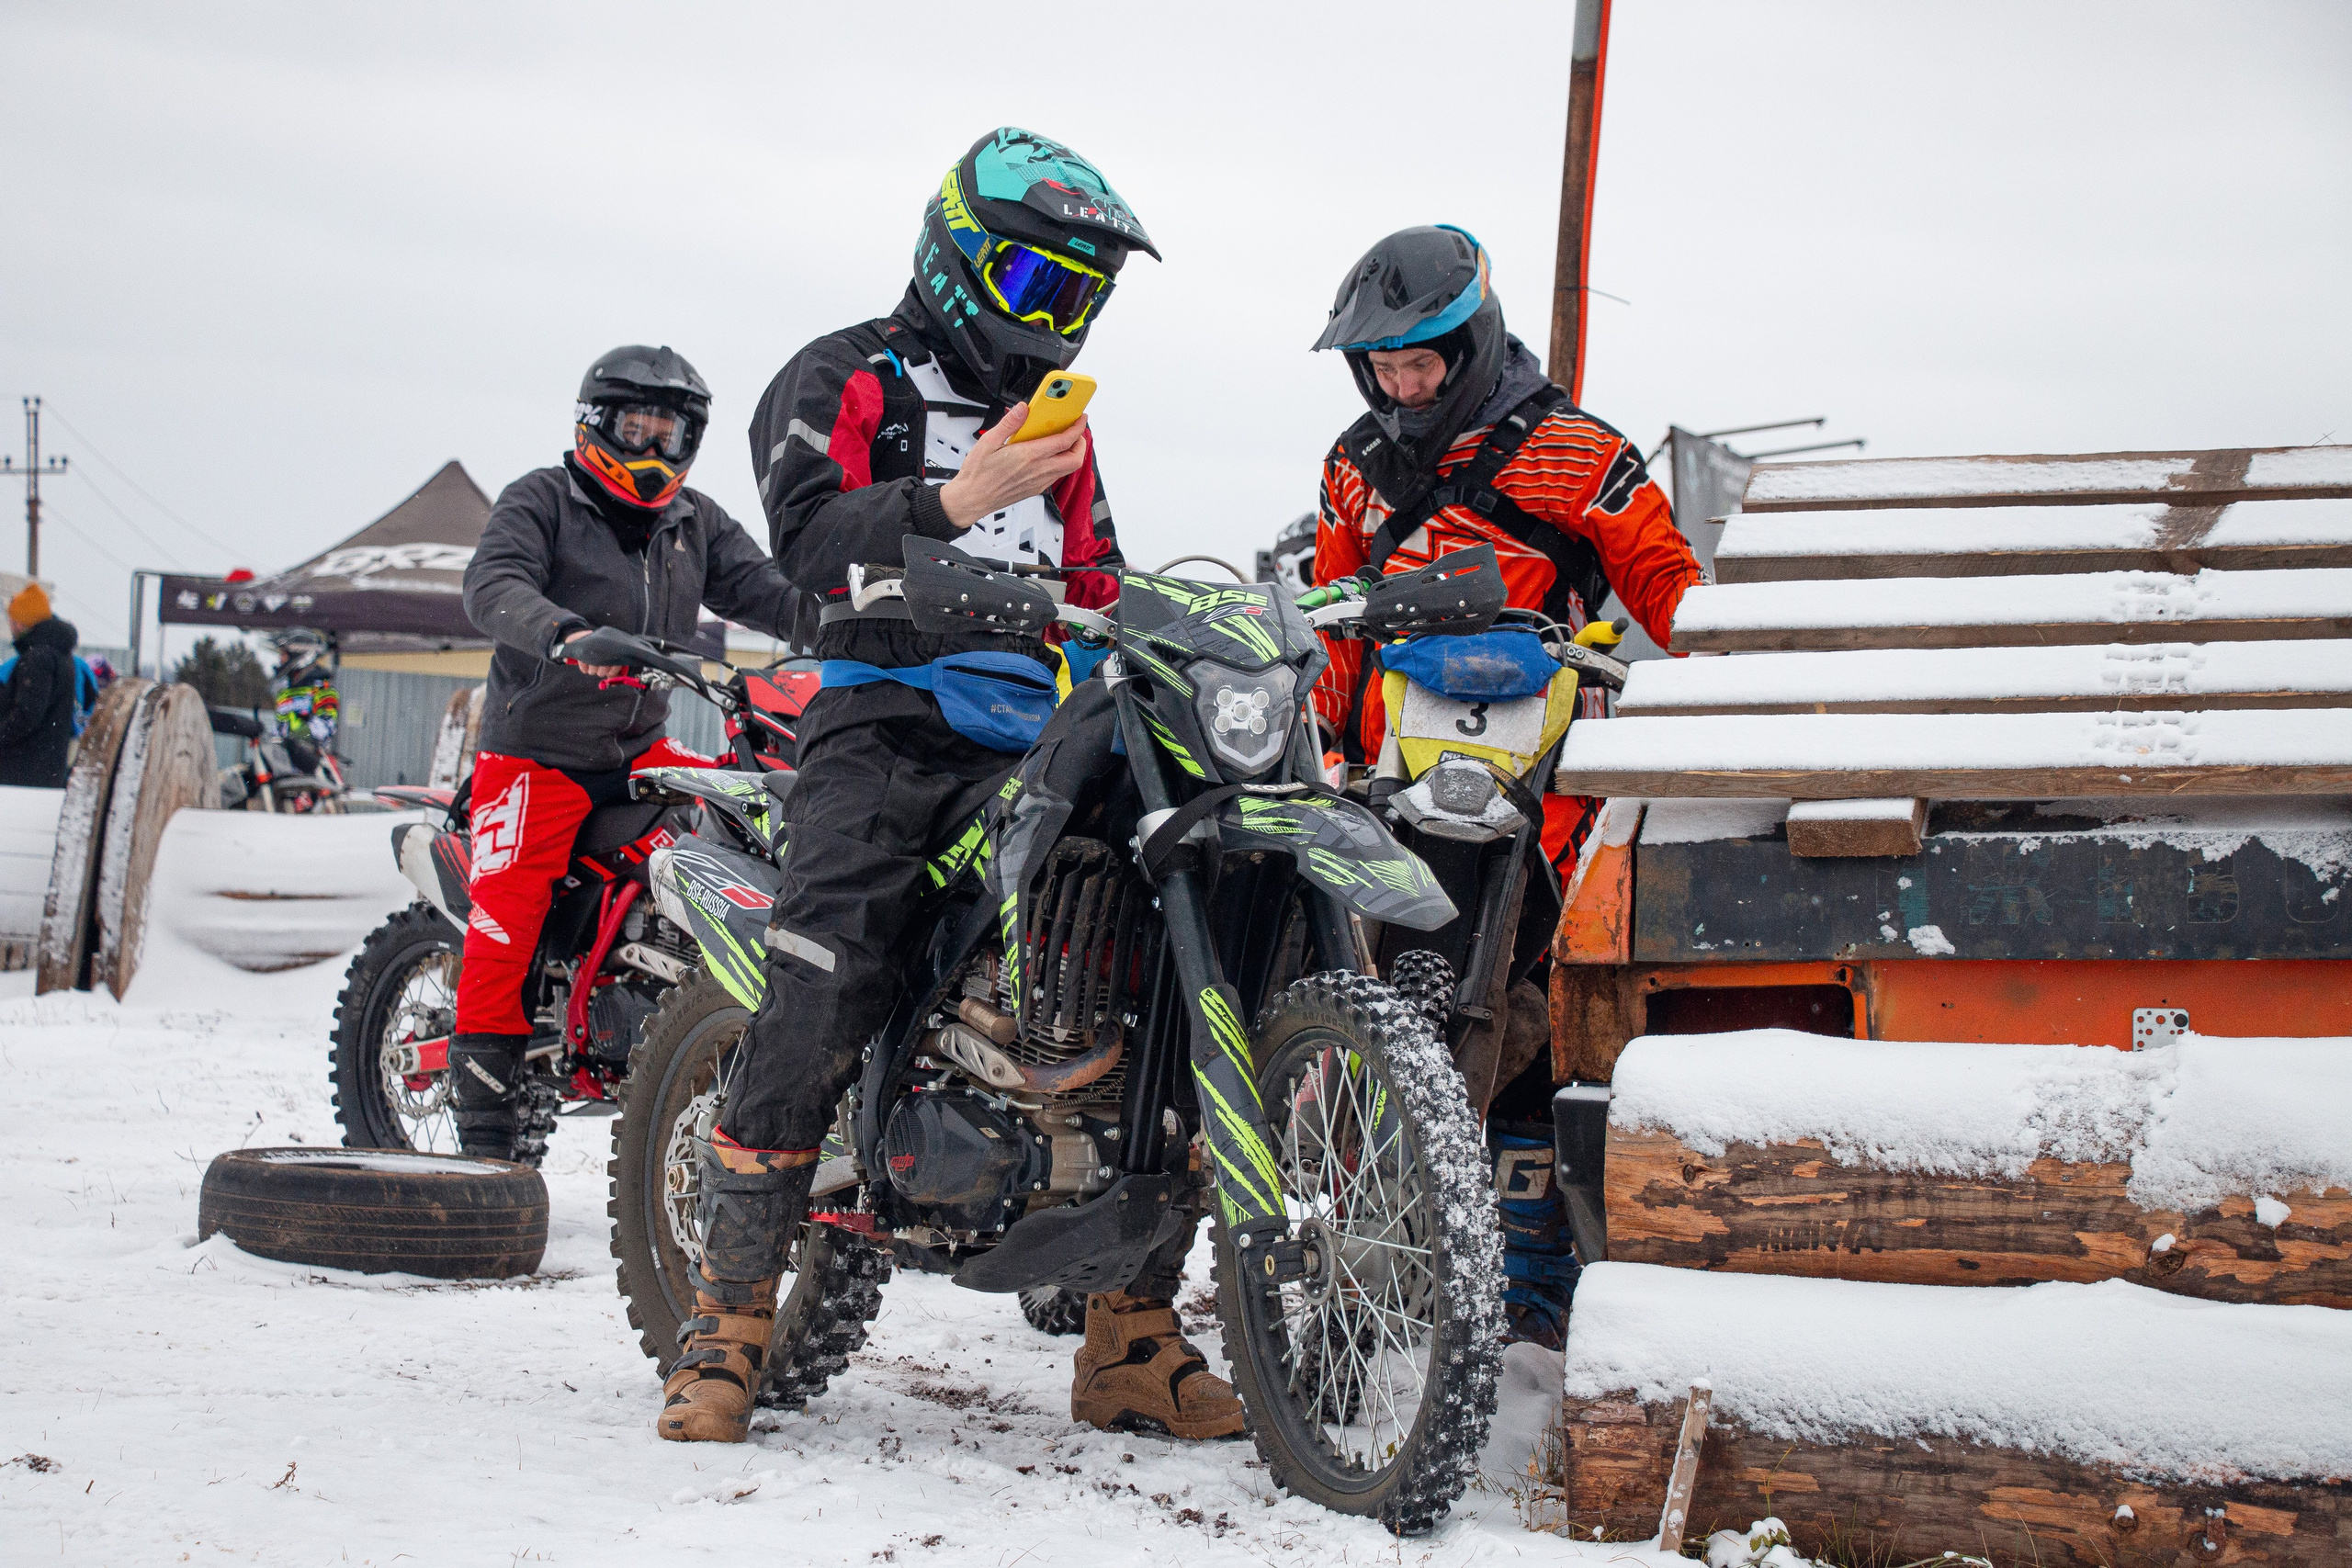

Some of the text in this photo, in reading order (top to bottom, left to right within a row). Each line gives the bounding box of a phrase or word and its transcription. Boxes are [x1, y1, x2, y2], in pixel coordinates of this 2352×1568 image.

[940, 162, 981, 233] EATT
[1063, 203, 1131, 234] LEATT
[972, 236, 991, 269] LEATT
[1074, 240, 1092, 251] LEATT
[1186, 590, 1268, 616] BSE
[685, 879, 731, 922] BSE RUSSIA
[1493, 1148, 1554, 1200] G
